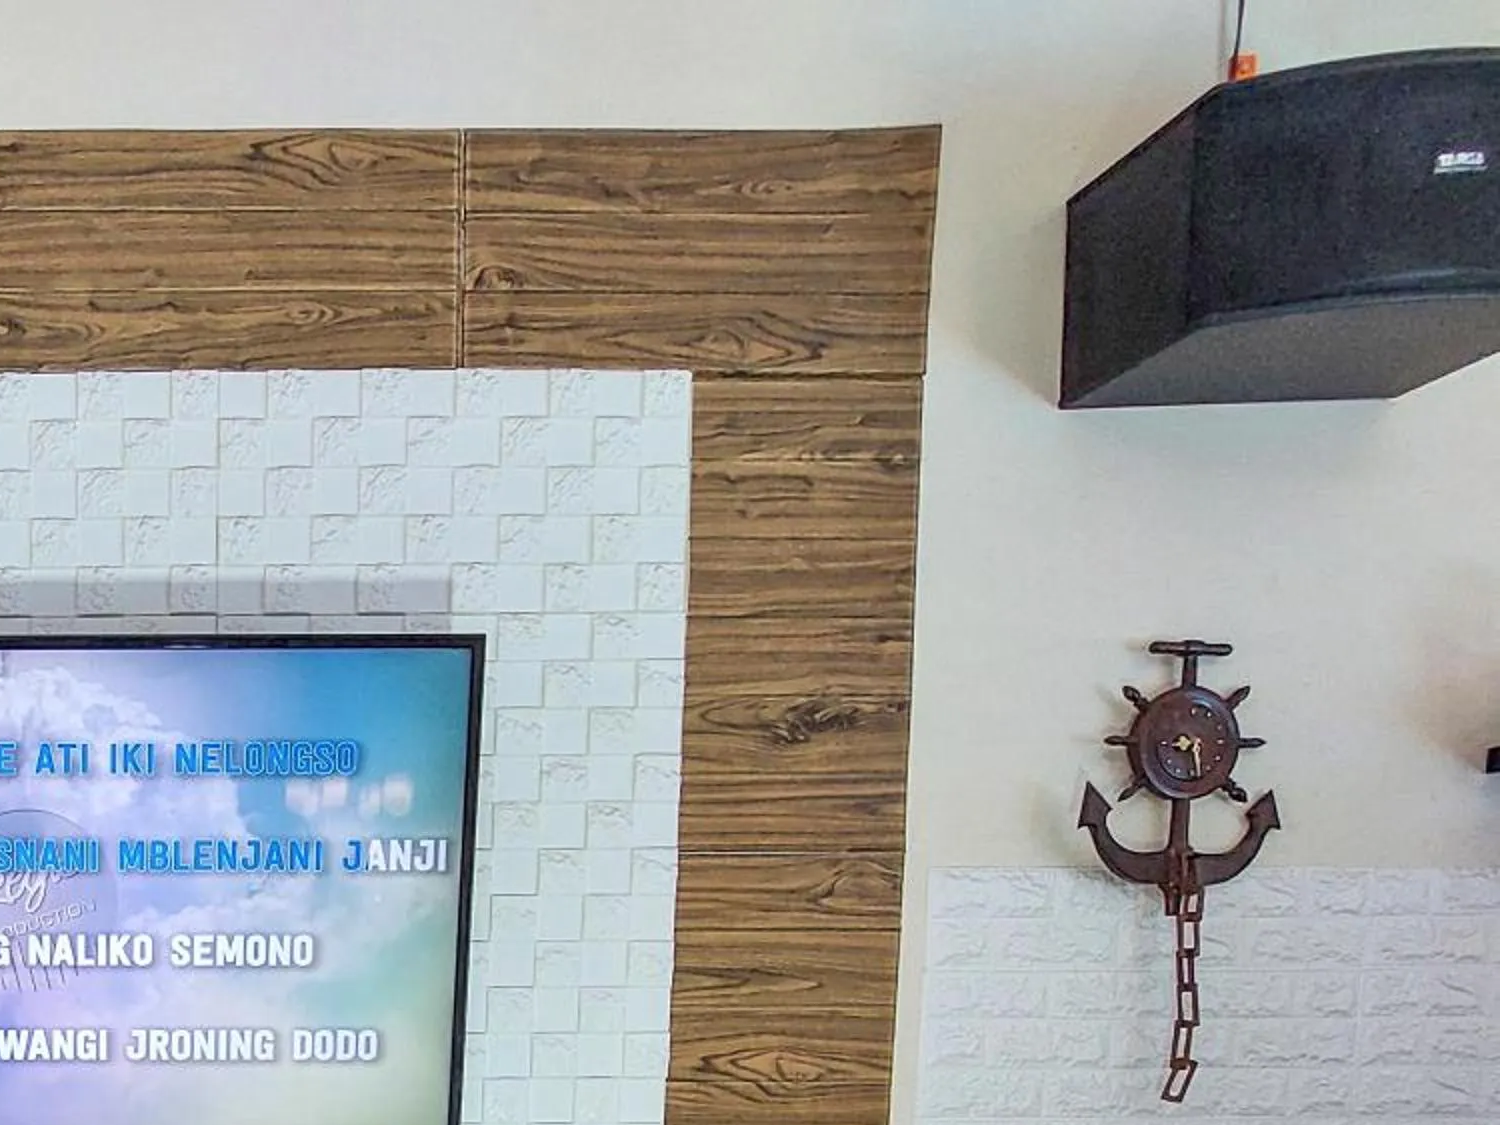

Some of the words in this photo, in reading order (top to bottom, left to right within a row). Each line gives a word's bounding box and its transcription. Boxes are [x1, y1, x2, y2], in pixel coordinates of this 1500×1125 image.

[34, 741, 90, 777] ATI
[109, 741, 155, 777] IKI
[173, 741, 359, 777] NELONGSO
[116, 837, 324, 873] MBLENJANI
[341, 837, 448, 873] JANJI
[27, 932, 154, 968] NALIKO
[170, 932, 315, 968] SEMONO
[125, 1028, 276, 1062] JRONING
[292, 1028, 380, 1062] DODO
